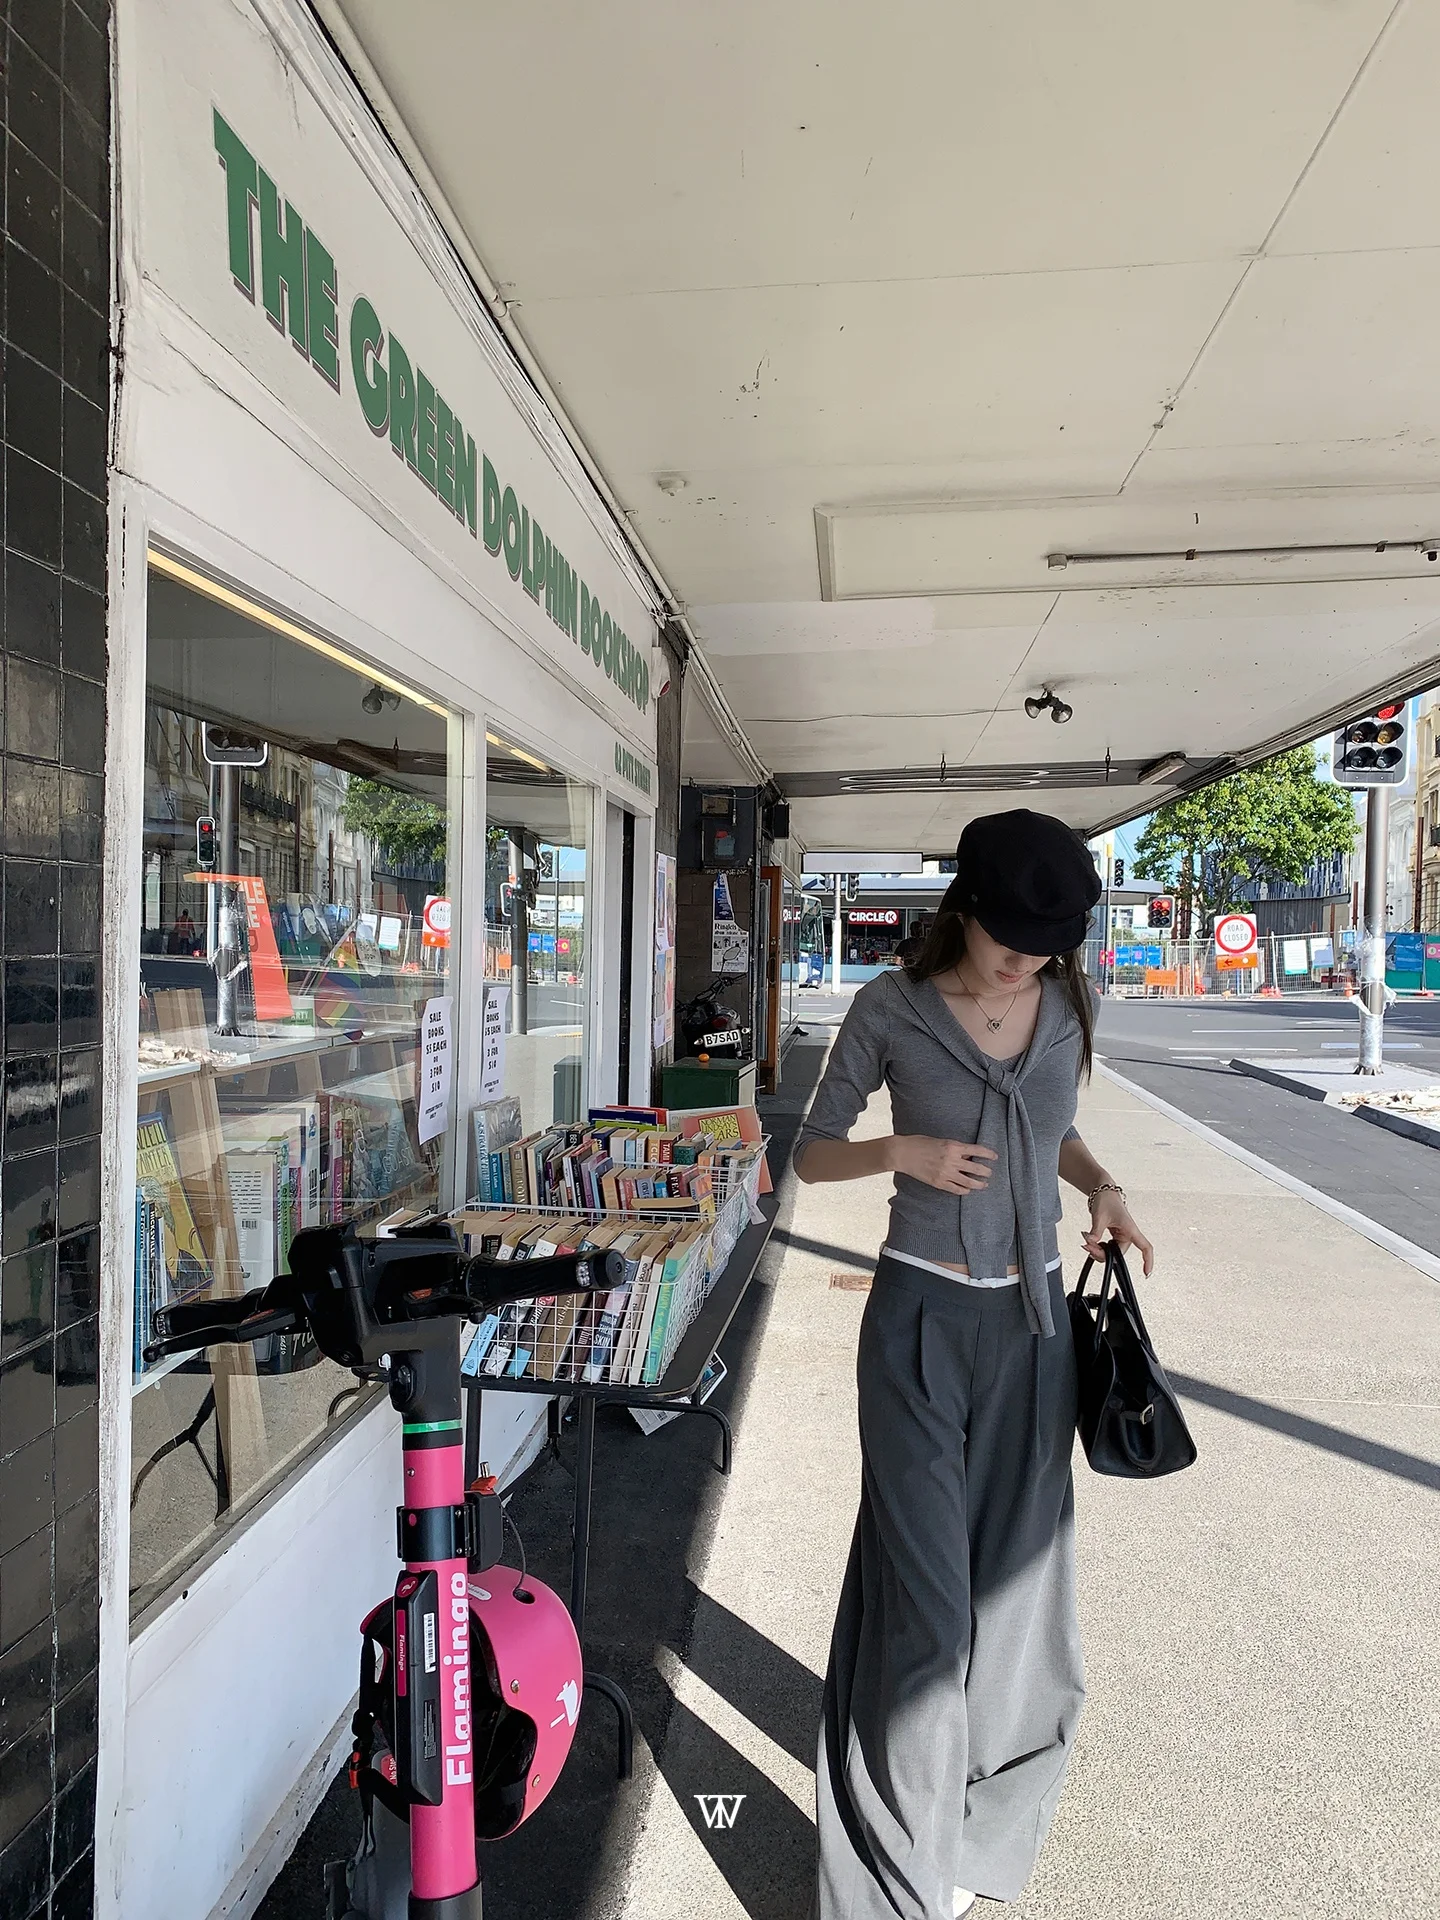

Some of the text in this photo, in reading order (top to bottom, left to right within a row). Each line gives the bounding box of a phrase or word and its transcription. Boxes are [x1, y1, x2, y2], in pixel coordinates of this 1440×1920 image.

[212, 105, 650, 716] THE GREEN DOLPHIN BOOKSHOP
[849, 911, 897, 923] CIRCLE K
[1227, 923, 1244, 931] ROAD
[488, 1000, 498, 1009] SALE
[430, 1011, 442, 1023] SALE
[486, 1012, 499, 1022] BOOKS
[428, 1026, 444, 1039] BOOKS
[491, 1024, 501, 1035] EACH
[706, 1031, 740, 1046] B7SAD
[433, 1039, 447, 1052] EACH
[491, 1046, 499, 1056] FOR
[488, 1060, 497, 1070] $10
[430, 1065, 443, 1078] 3 FOR
[431, 1081, 441, 1093] $10
[701, 1115, 736, 1125] NORMAN
[701, 1122, 737, 1133] LINDSAY'S
[594, 1333, 611, 1347] SKIN
[443, 1572, 472, 1786] Flamingo
[389, 1770, 397, 1781] No
